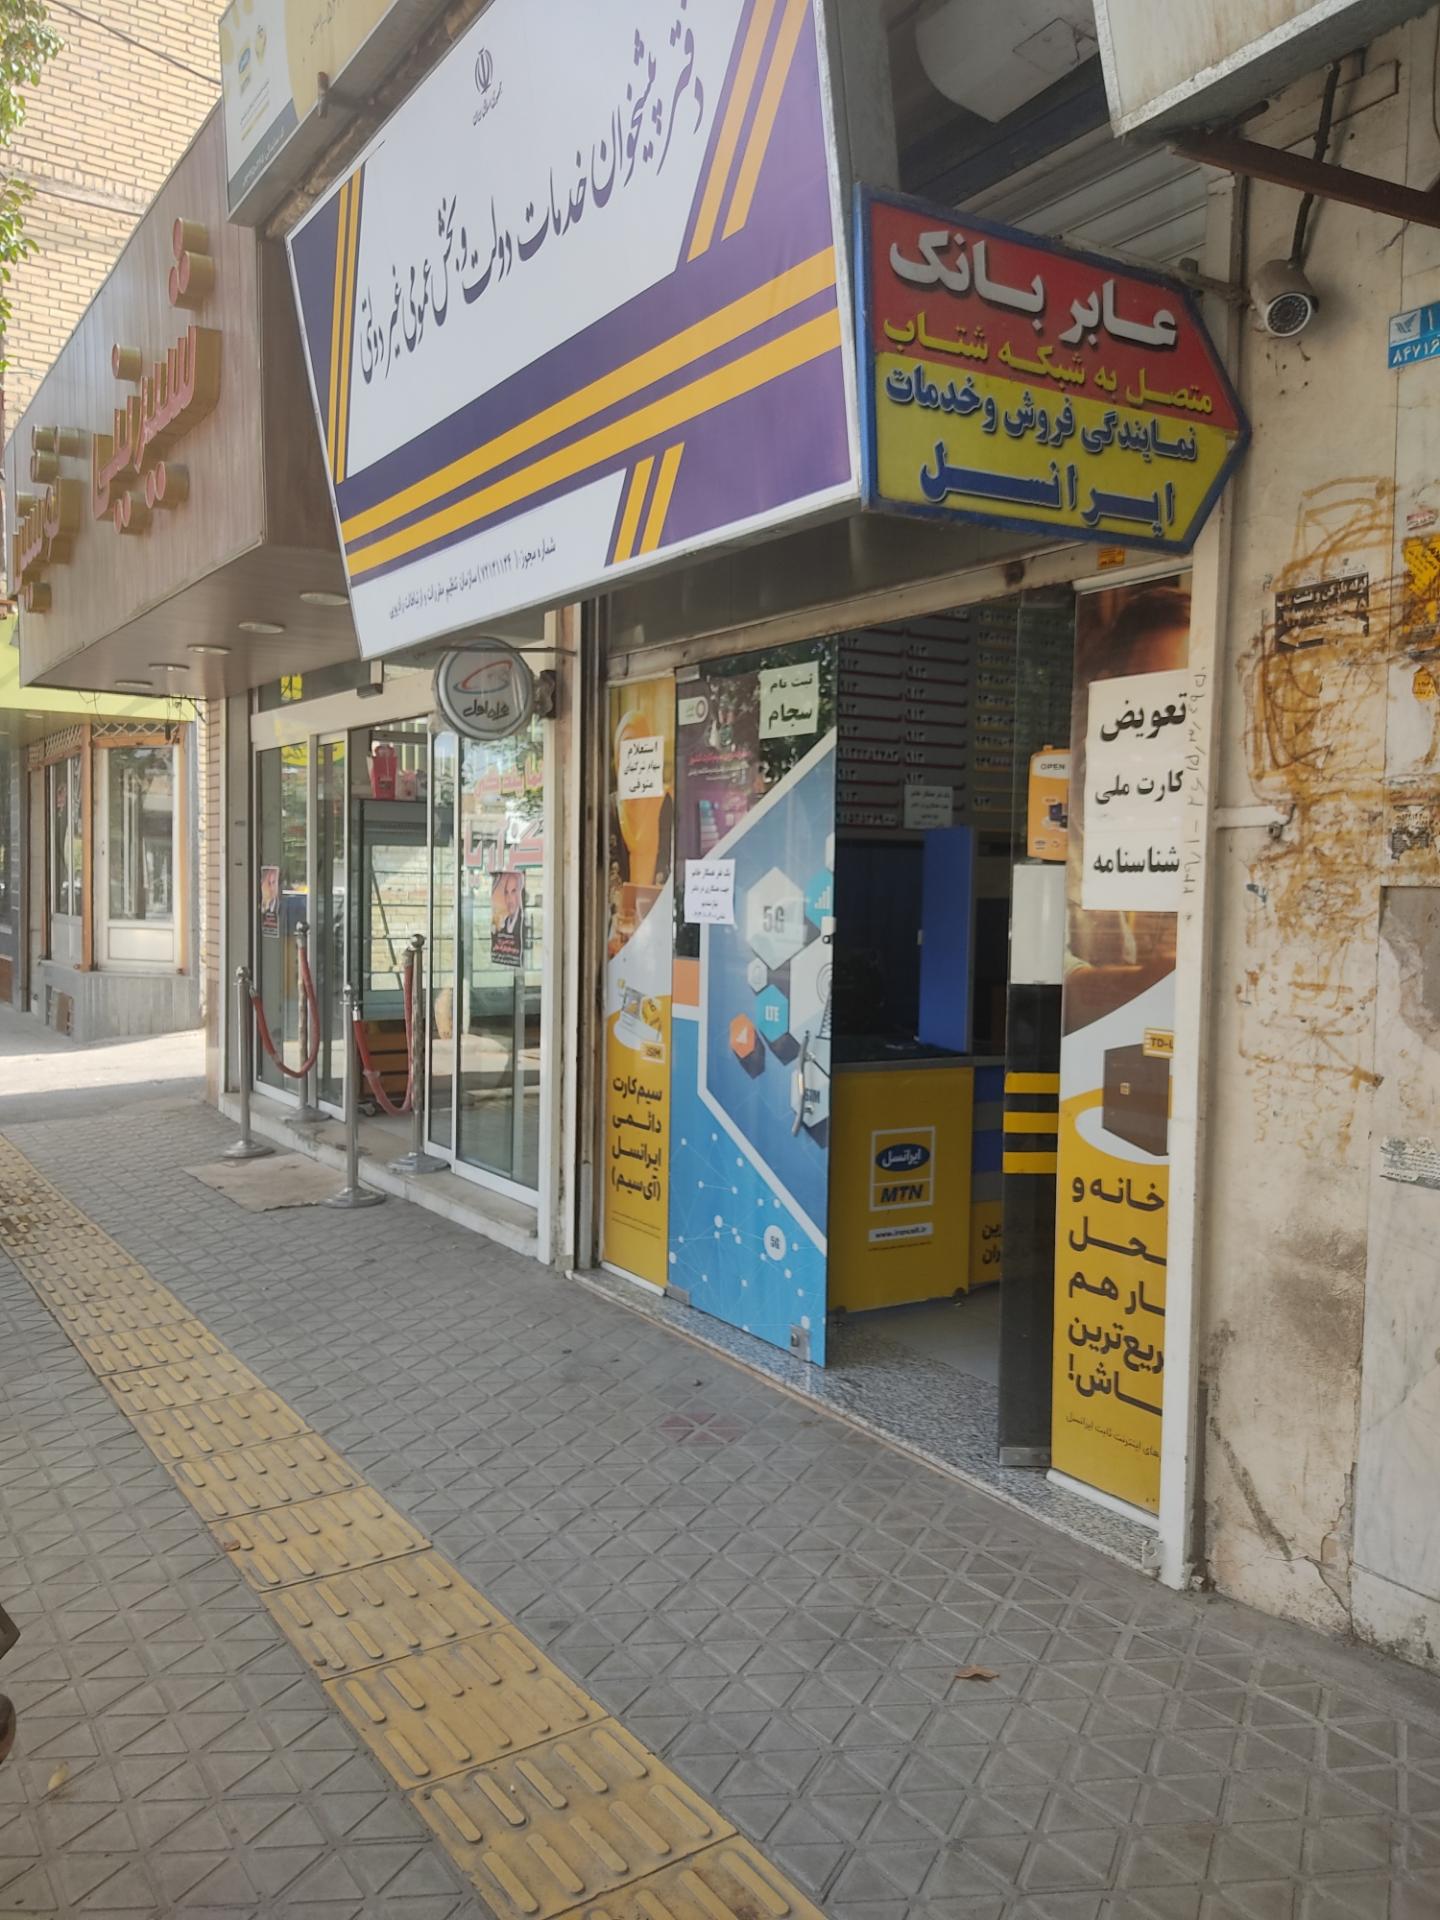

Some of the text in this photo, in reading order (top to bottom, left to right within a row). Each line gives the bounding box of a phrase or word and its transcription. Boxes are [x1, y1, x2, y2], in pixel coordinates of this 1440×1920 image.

[655, 0, 705, 176] دفتر
[591, 28, 662, 209] پیشخوان
[517, 150, 587, 262] خدمات
[431, 194, 458, 327] بخش
[461, 195, 512, 304] دولت
[402, 258, 431, 352] عمومی
[889, 230, 1177, 349] عابر بانک
[361, 286, 384, 384] دولتی
[385, 264, 401, 379] غیر
[883, 311, 1214, 415] متصل به شبکه شتاب
[1002, 391, 1076, 447] فروش
[1081, 410, 1197, 463] نمایندگی
[769, 673, 813, 693] ثبت نام
[768, 706, 813, 731] سجام
[1100, 692, 1188, 742] تعویض
[1040, 763, 1065, 771] OPEN
[1095, 768, 1184, 805] کارت ملی
[1092, 845, 1180, 874] شناسنامه
[763, 906, 785, 933] 5G
[765, 1006, 780, 1022] LTE
[612, 1136, 661, 1171] ایرانسل
[882, 1148, 922, 1168] ایرانسل
[881, 1184, 923, 1203] MTN
[1071, 1175, 1165, 1212] خانه و
[1068, 1272, 1119, 1298] هم
